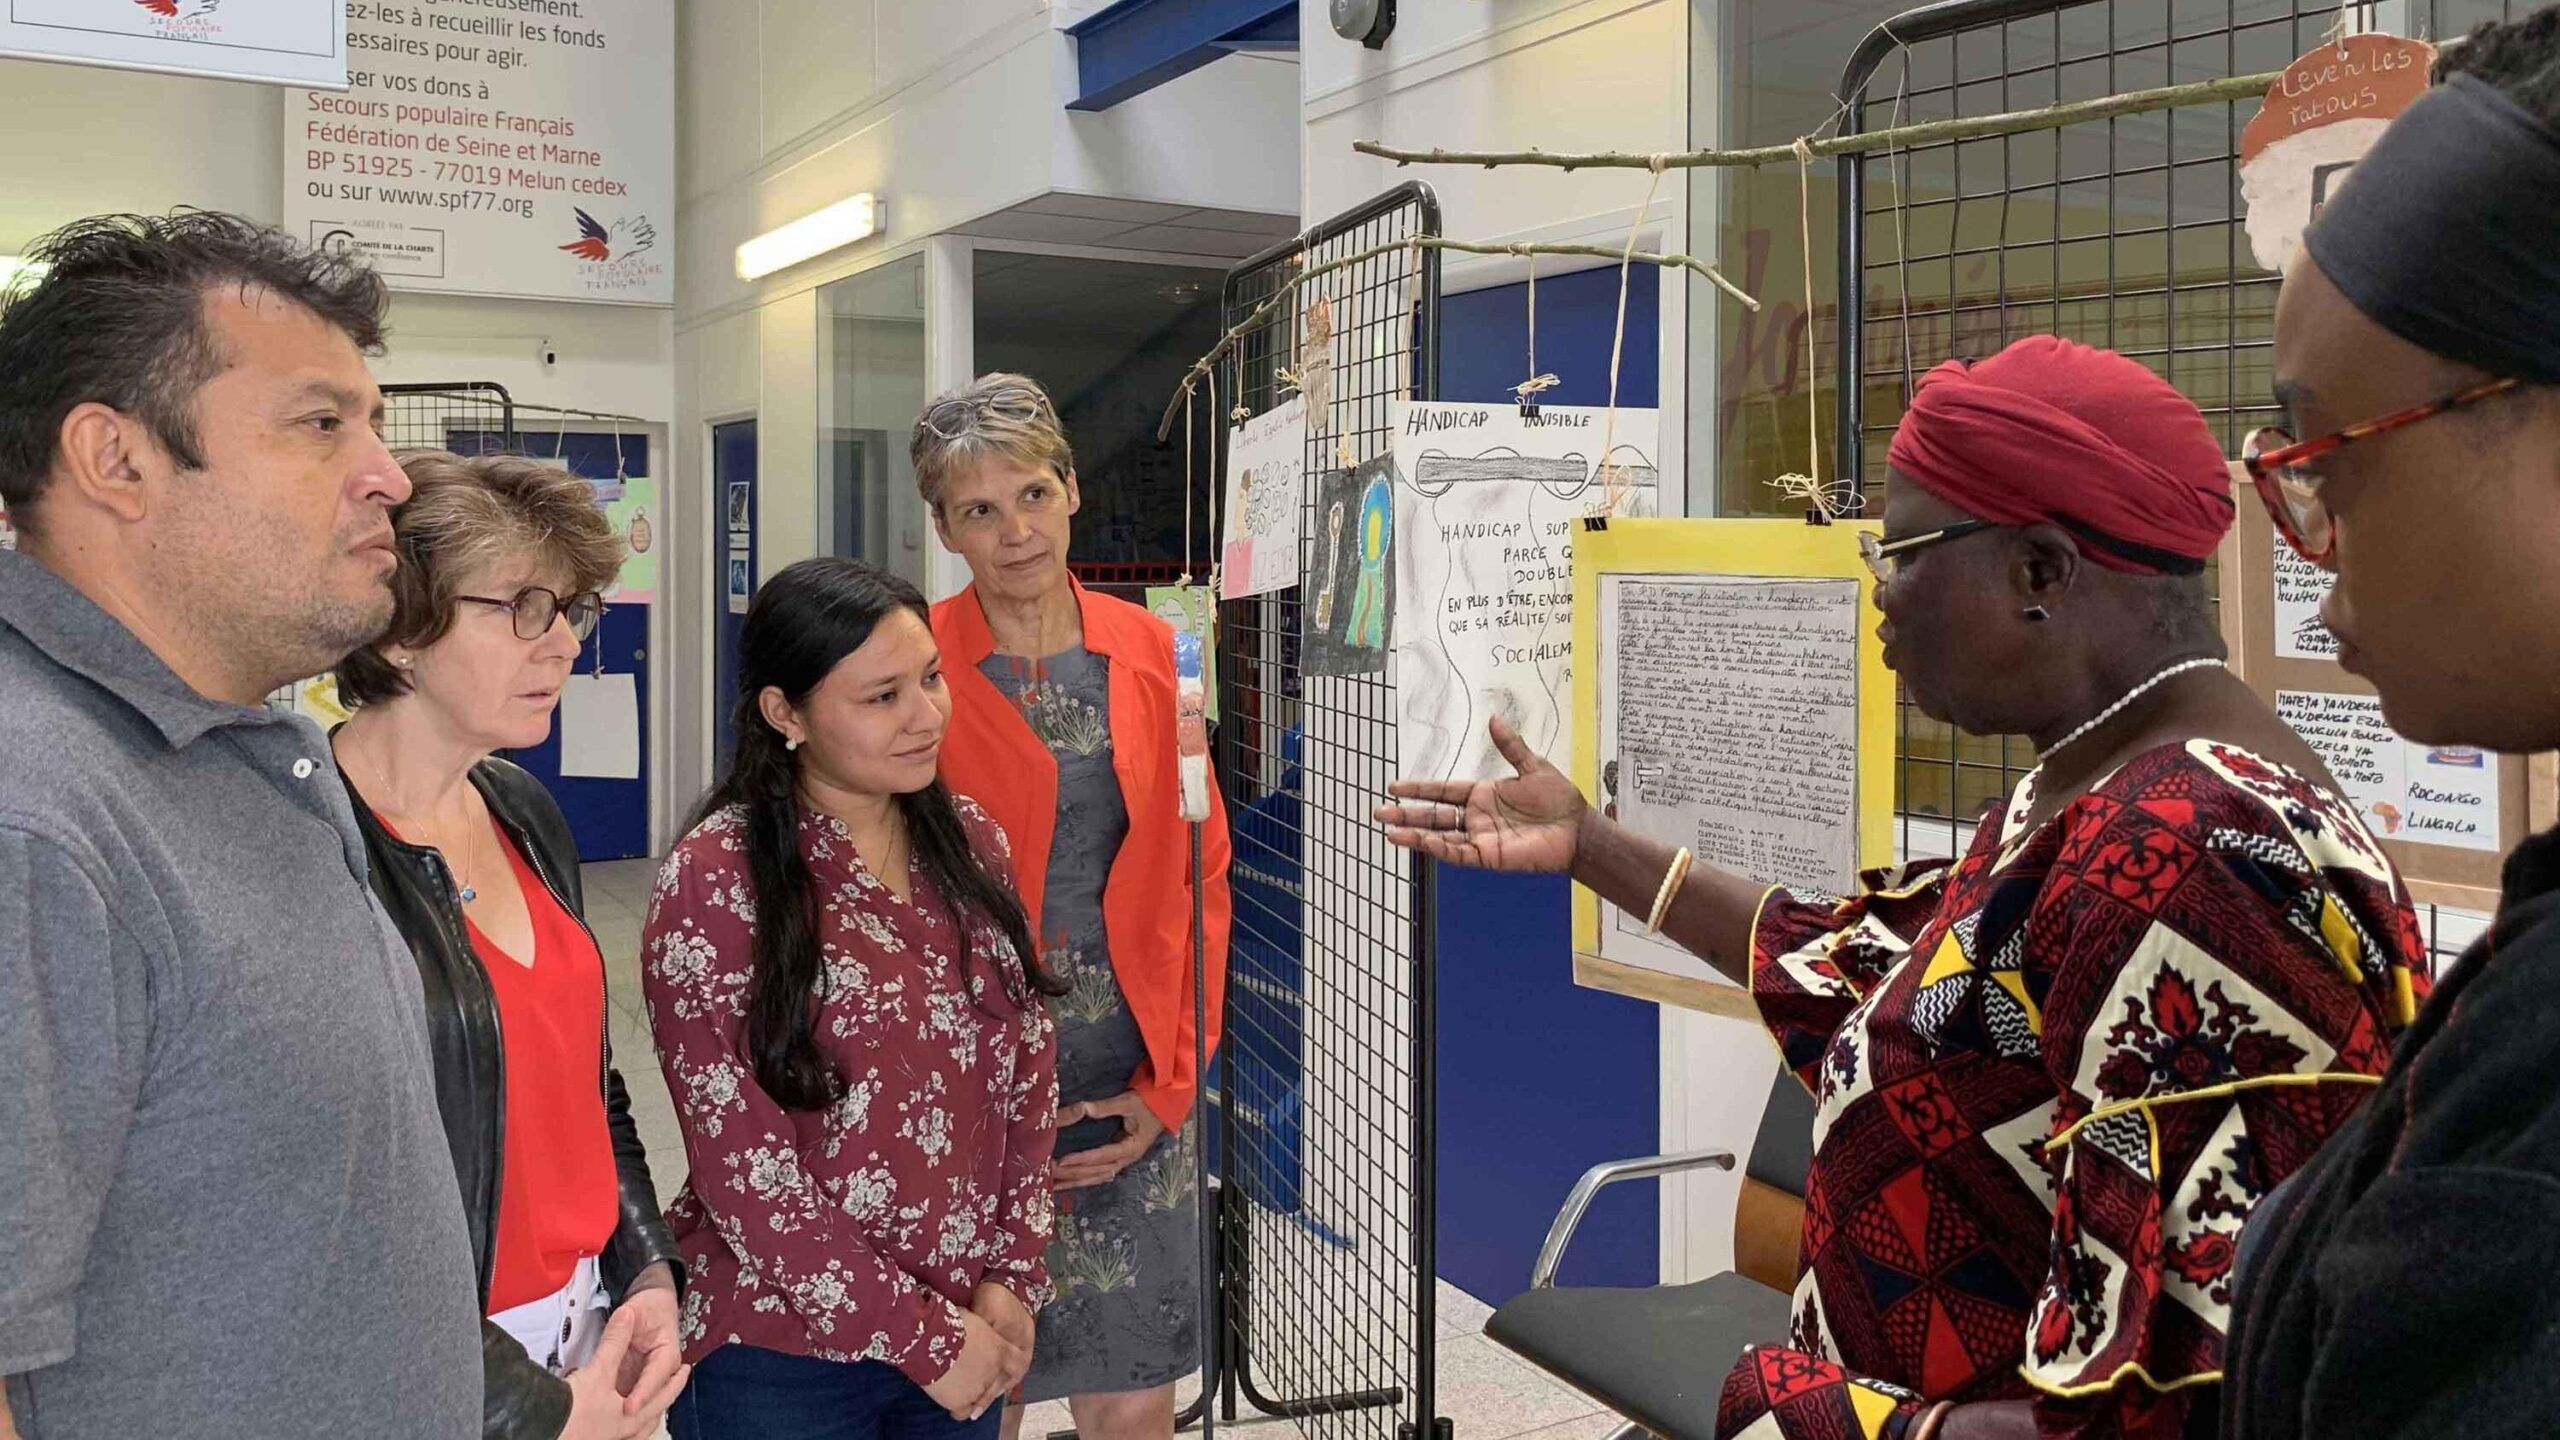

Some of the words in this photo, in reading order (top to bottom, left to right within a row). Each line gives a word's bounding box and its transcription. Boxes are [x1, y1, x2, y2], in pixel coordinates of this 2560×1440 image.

[411, 7, 421, 26] à
[429, 13, 513, 38] recueillir
[520, 20, 546, 41] les
[553, 24, 605, 48] fonds
[435, 41, 479, 62] pour
[487, 47, 527, 69] agir.
[383, 75, 416, 92] vos
[424, 76, 471, 98] dons
[478, 81, 489, 99] à
[308, 92, 389, 118] Secours
[397, 103, 488, 127] populaire
[495, 111, 574, 137] Français
[308, 121, 418, 151] Fédération
[426, 129, 449, 151] de
[457, 136, 510, 158] Seine
[517, 142, 535, 160] et
[543, 142, 601, 166] Marne
[307, 151, 335, 170] BP
[343, 155, 412, 178] 51925
[433, 162, 501, 186] 77019
[508, 169, 565, 191] Melun
[572, 176, 627, 196] cedex
[307, 182, 333, 198] ou
[341, 184, 372, 200] sur
[379, 186, 533, 218] www.spf77.org
[1406, 407, 1489, 436] HANDICAP
[1441, 522, 1521, 543] HANDICAP
[1503, 546, 1546, 563] PARCE
[1448, 597, 1461, 613] EN
[1467, 595, 1489, 610] PLUS
[1449, 620, 1468, 636] QUE
[1476, 618, 1488, 630] SA
